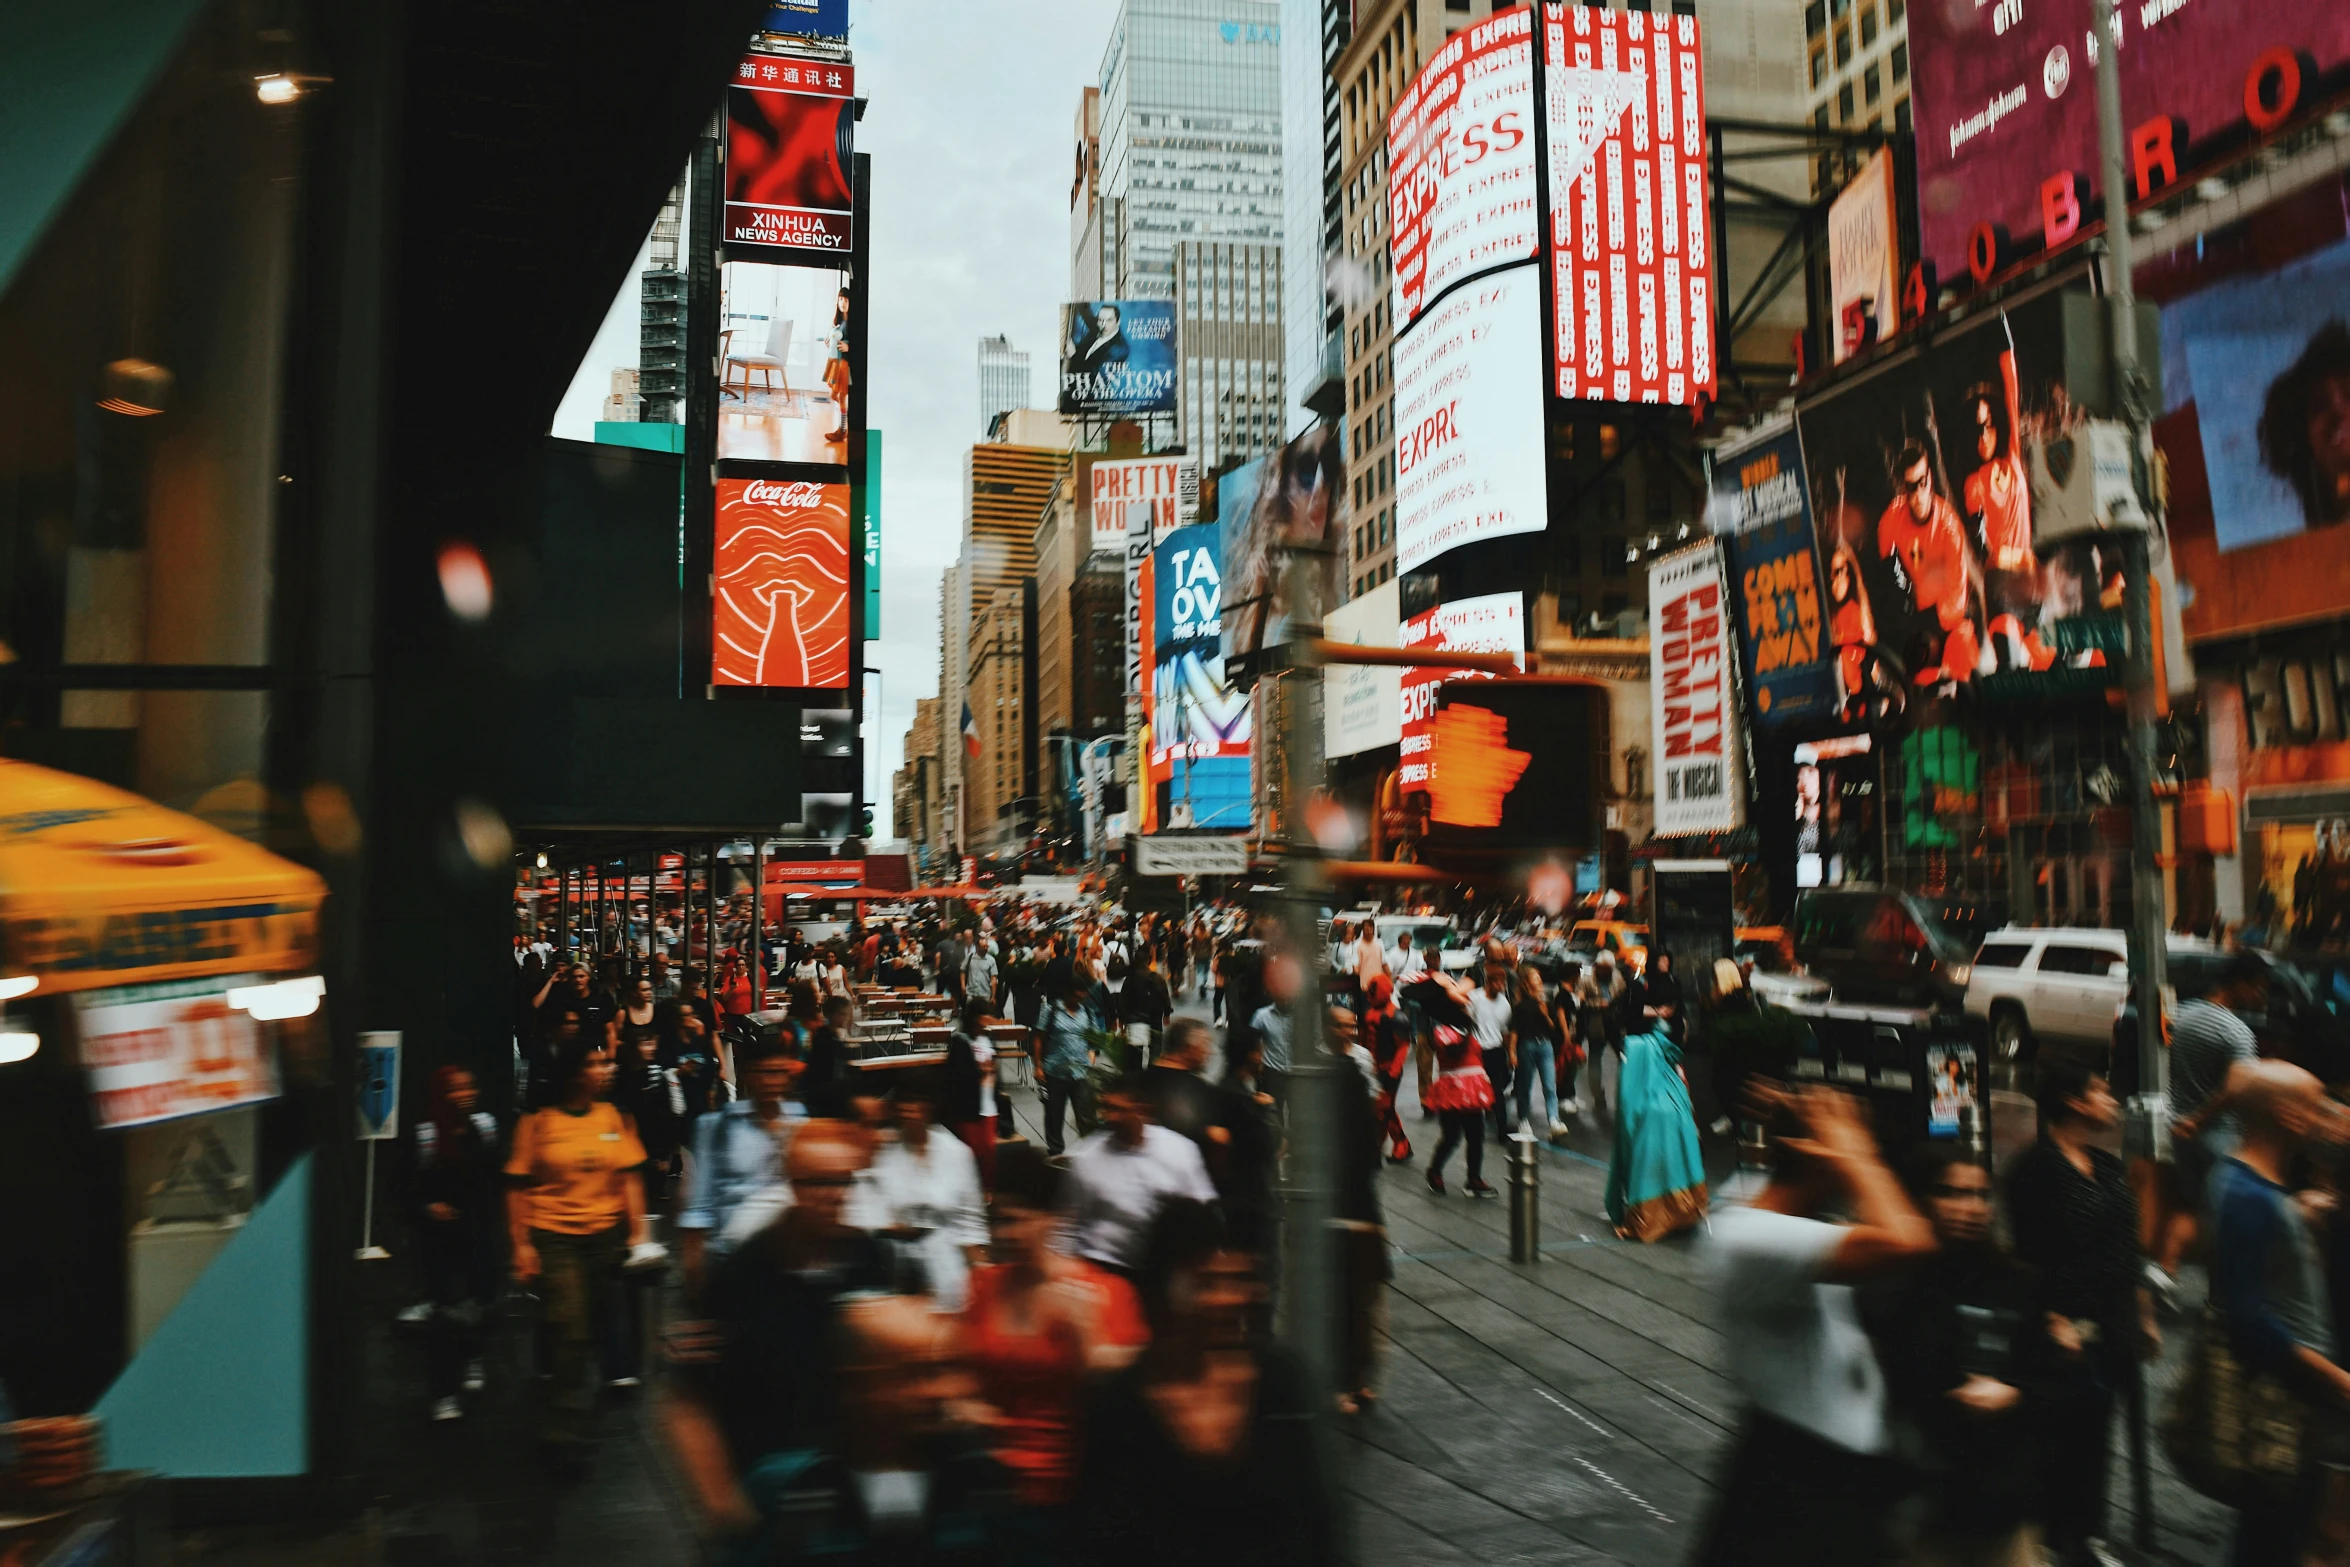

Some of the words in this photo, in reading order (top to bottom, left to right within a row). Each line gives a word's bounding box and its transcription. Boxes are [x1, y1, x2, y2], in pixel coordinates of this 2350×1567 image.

[740, 62, 842, 89] 新华通讯社
[1421, 36, 1463, 96] EXPRESS
[1418, 71, 1458, 128] EXPRESS
[1394, 112, 1525, 241] EXPRESS
[735, 227, 778, 242] NEWS
[781, 230, 842, 247] AGENCY
[752, 212, 826, 233] XINHUA
[1061, 369, 1172, 391] PHANTOM
[743, 480, 825, 508] Coca-Cola
[1093, 463, 1178, 498] PRETTY
[1689, 581, 1724, 759] PRETTY
[1754, 623, 1821, 676] AWAY
[1660, 591, 1693, 761] WOMAN
